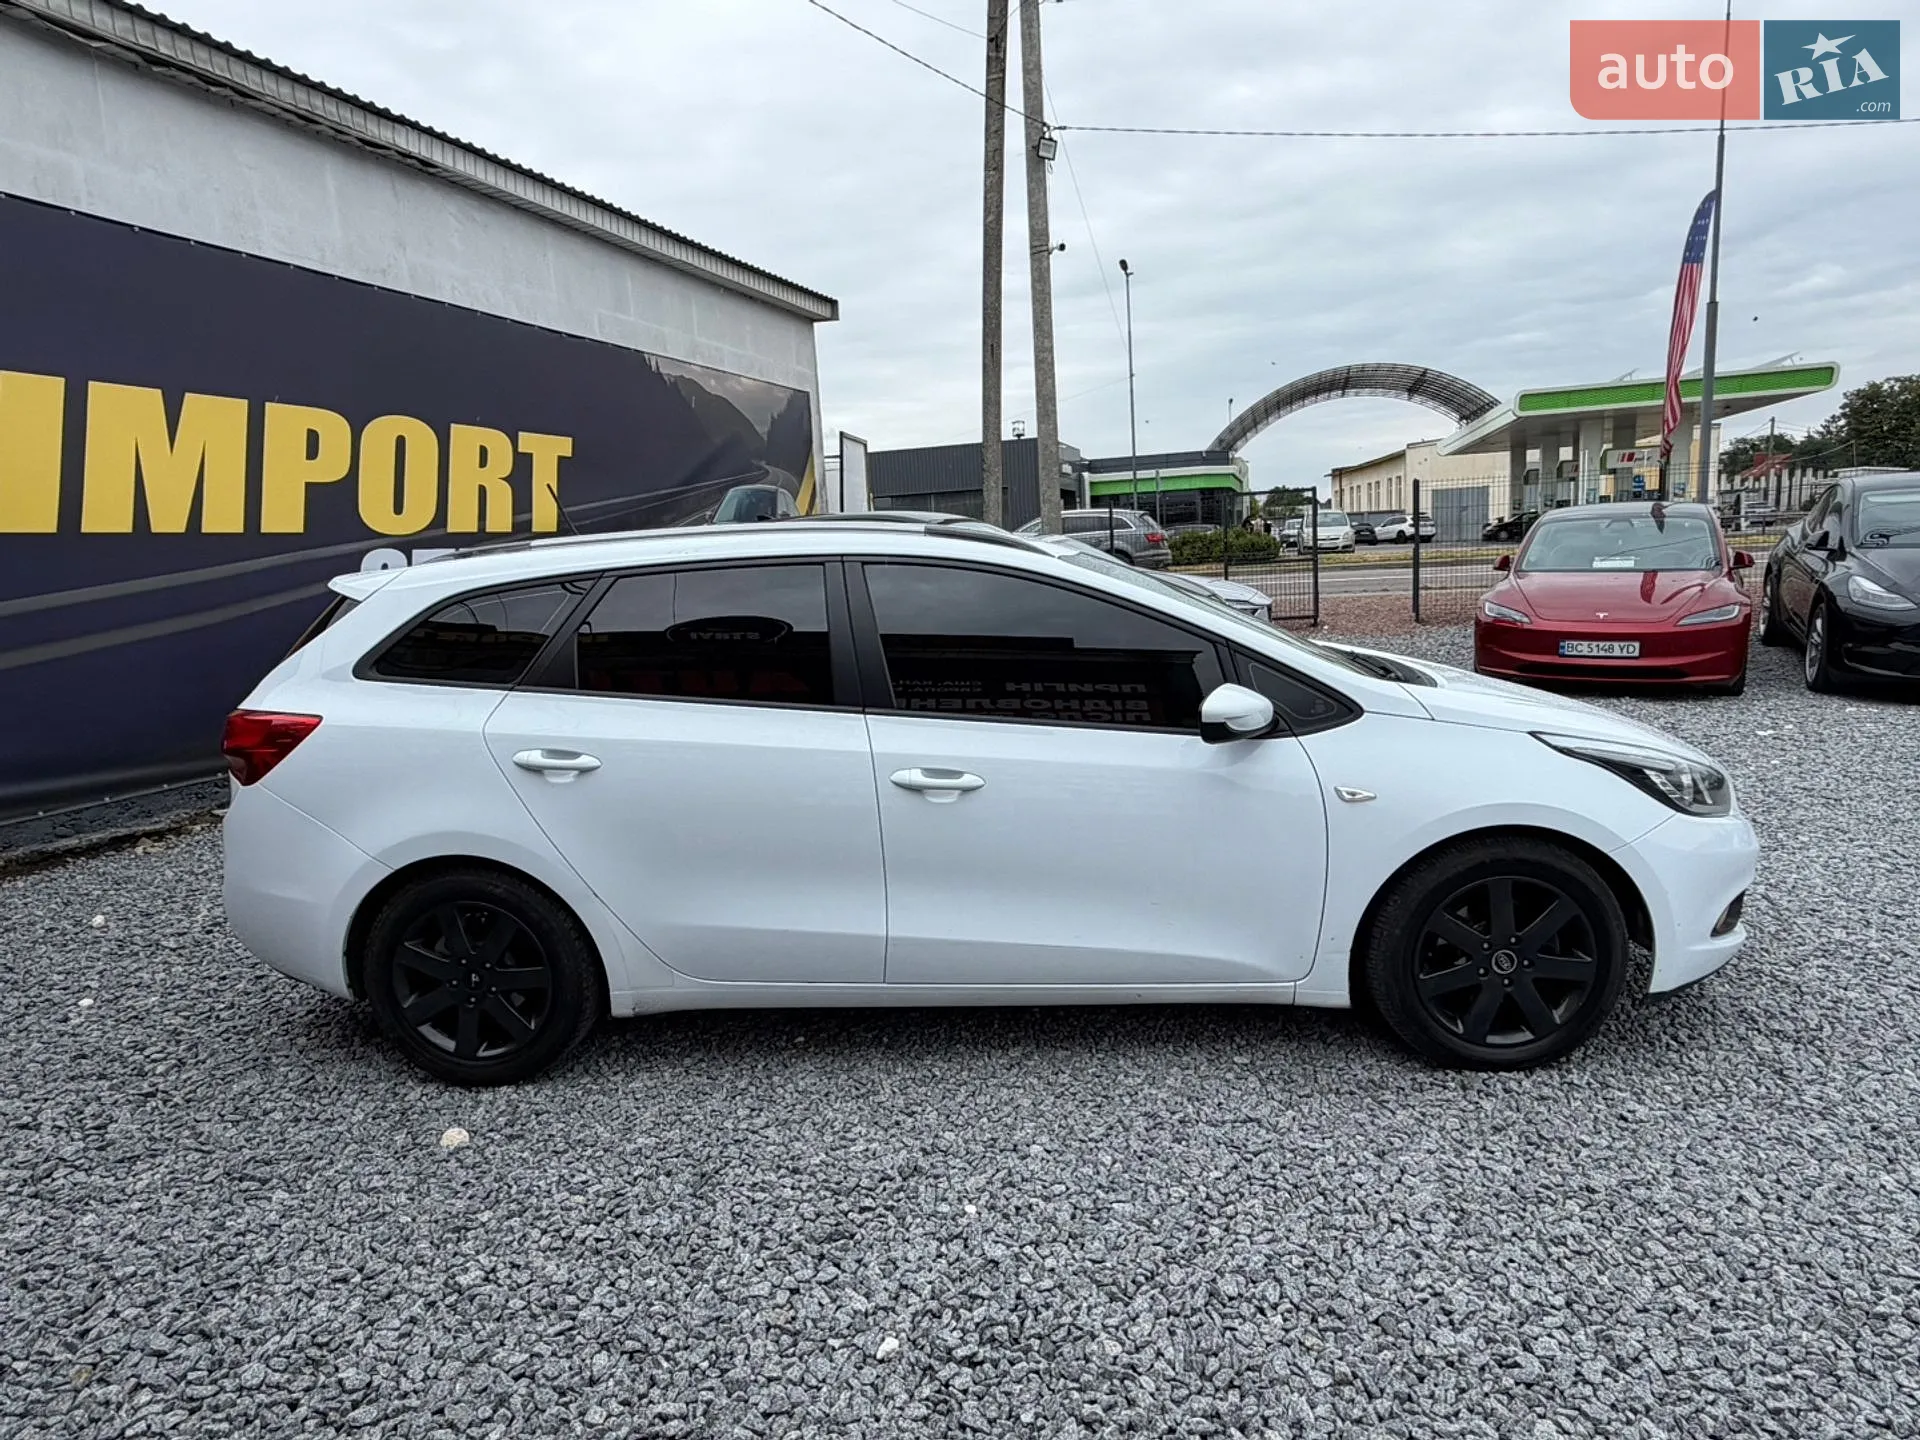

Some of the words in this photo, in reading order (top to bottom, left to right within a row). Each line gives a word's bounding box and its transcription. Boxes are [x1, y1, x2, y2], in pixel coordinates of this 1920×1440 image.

[0, 370, 573, 534] IMPORT
[1567, 643, 1583, 653] BC
[1587, 643, 1615, 654] 5148
[1616, 644, 1636, 654] YD
